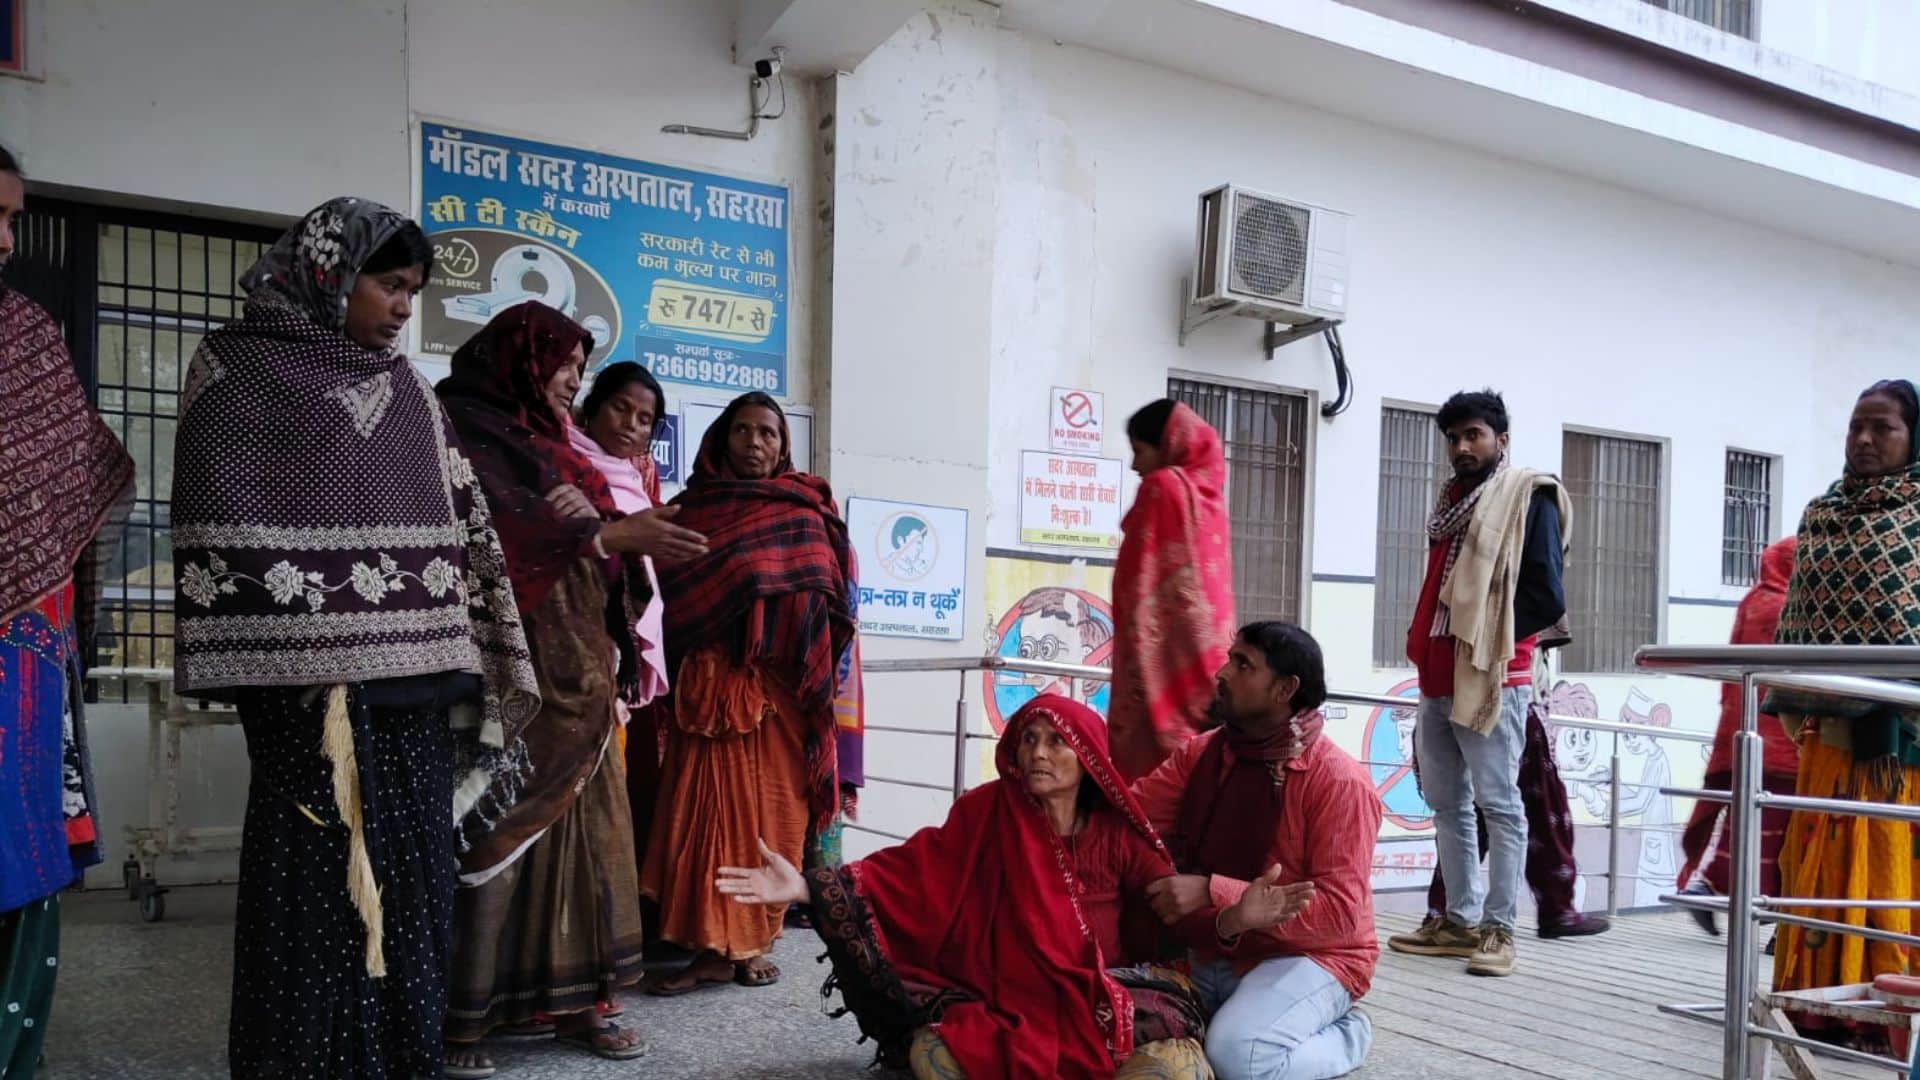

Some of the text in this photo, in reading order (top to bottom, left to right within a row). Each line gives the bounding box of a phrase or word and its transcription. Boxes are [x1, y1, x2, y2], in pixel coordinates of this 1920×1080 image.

[428, 129, 784, 228] मॉडल सदर अस्पताल, सहरसा
[543, 191, 557, 211] में
[428, 195, 582, 248] सी टी स्कैन
[433, 244, 473, 271] 24/7
[640, 231, 775, 268] सरकारी रेट से भी
[637, 252, 669, 271] कम
[719, 266, 742, 283] पर
[746, 271, 777, 288] मात्र
[683, 294, 744, 329] 747/-
[751, 307, 766, 331] से
[643, 352, 777, 390] 7366992886
[1055, 429, 1100, 442] NO SMOKING
[858, 587, 960, 620] त्र-तत्र न थूकें
